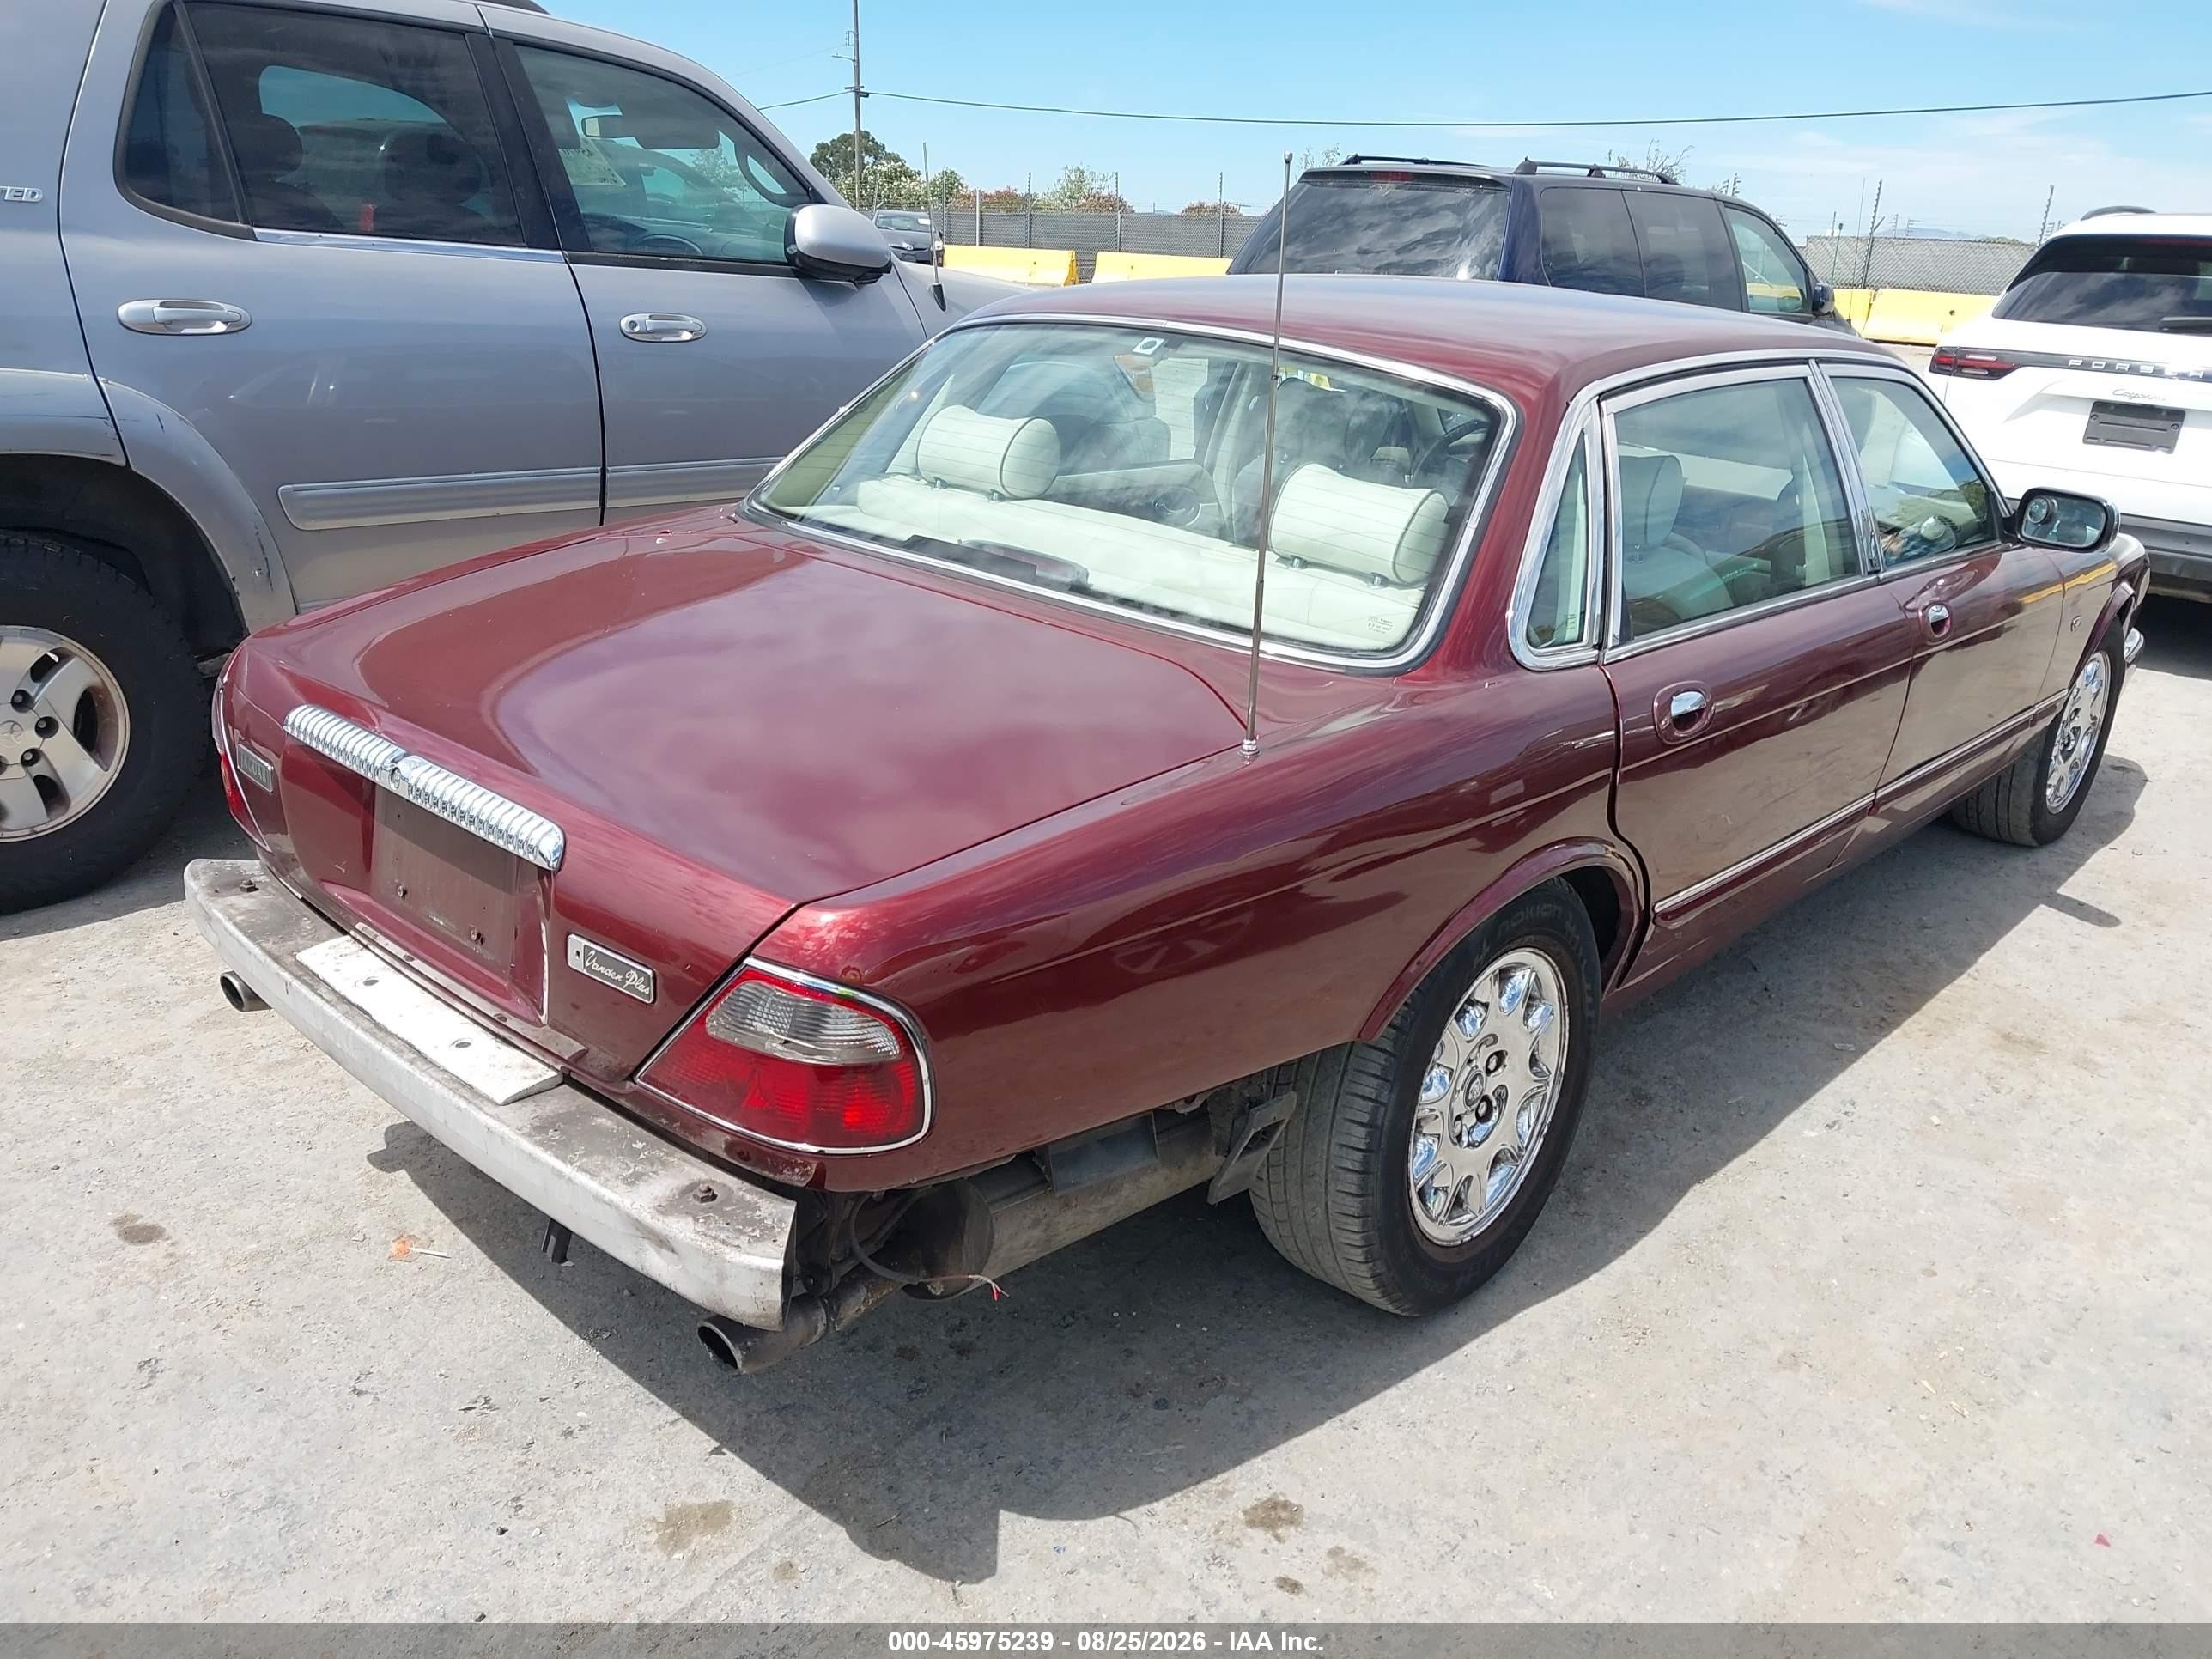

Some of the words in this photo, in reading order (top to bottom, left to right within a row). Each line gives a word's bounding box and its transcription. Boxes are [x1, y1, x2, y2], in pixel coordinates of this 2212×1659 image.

[2112, 388, 2167, 401] Caye
[585, 949, 623, 981] Vanden
[623, 969, 650, 994] Plas
